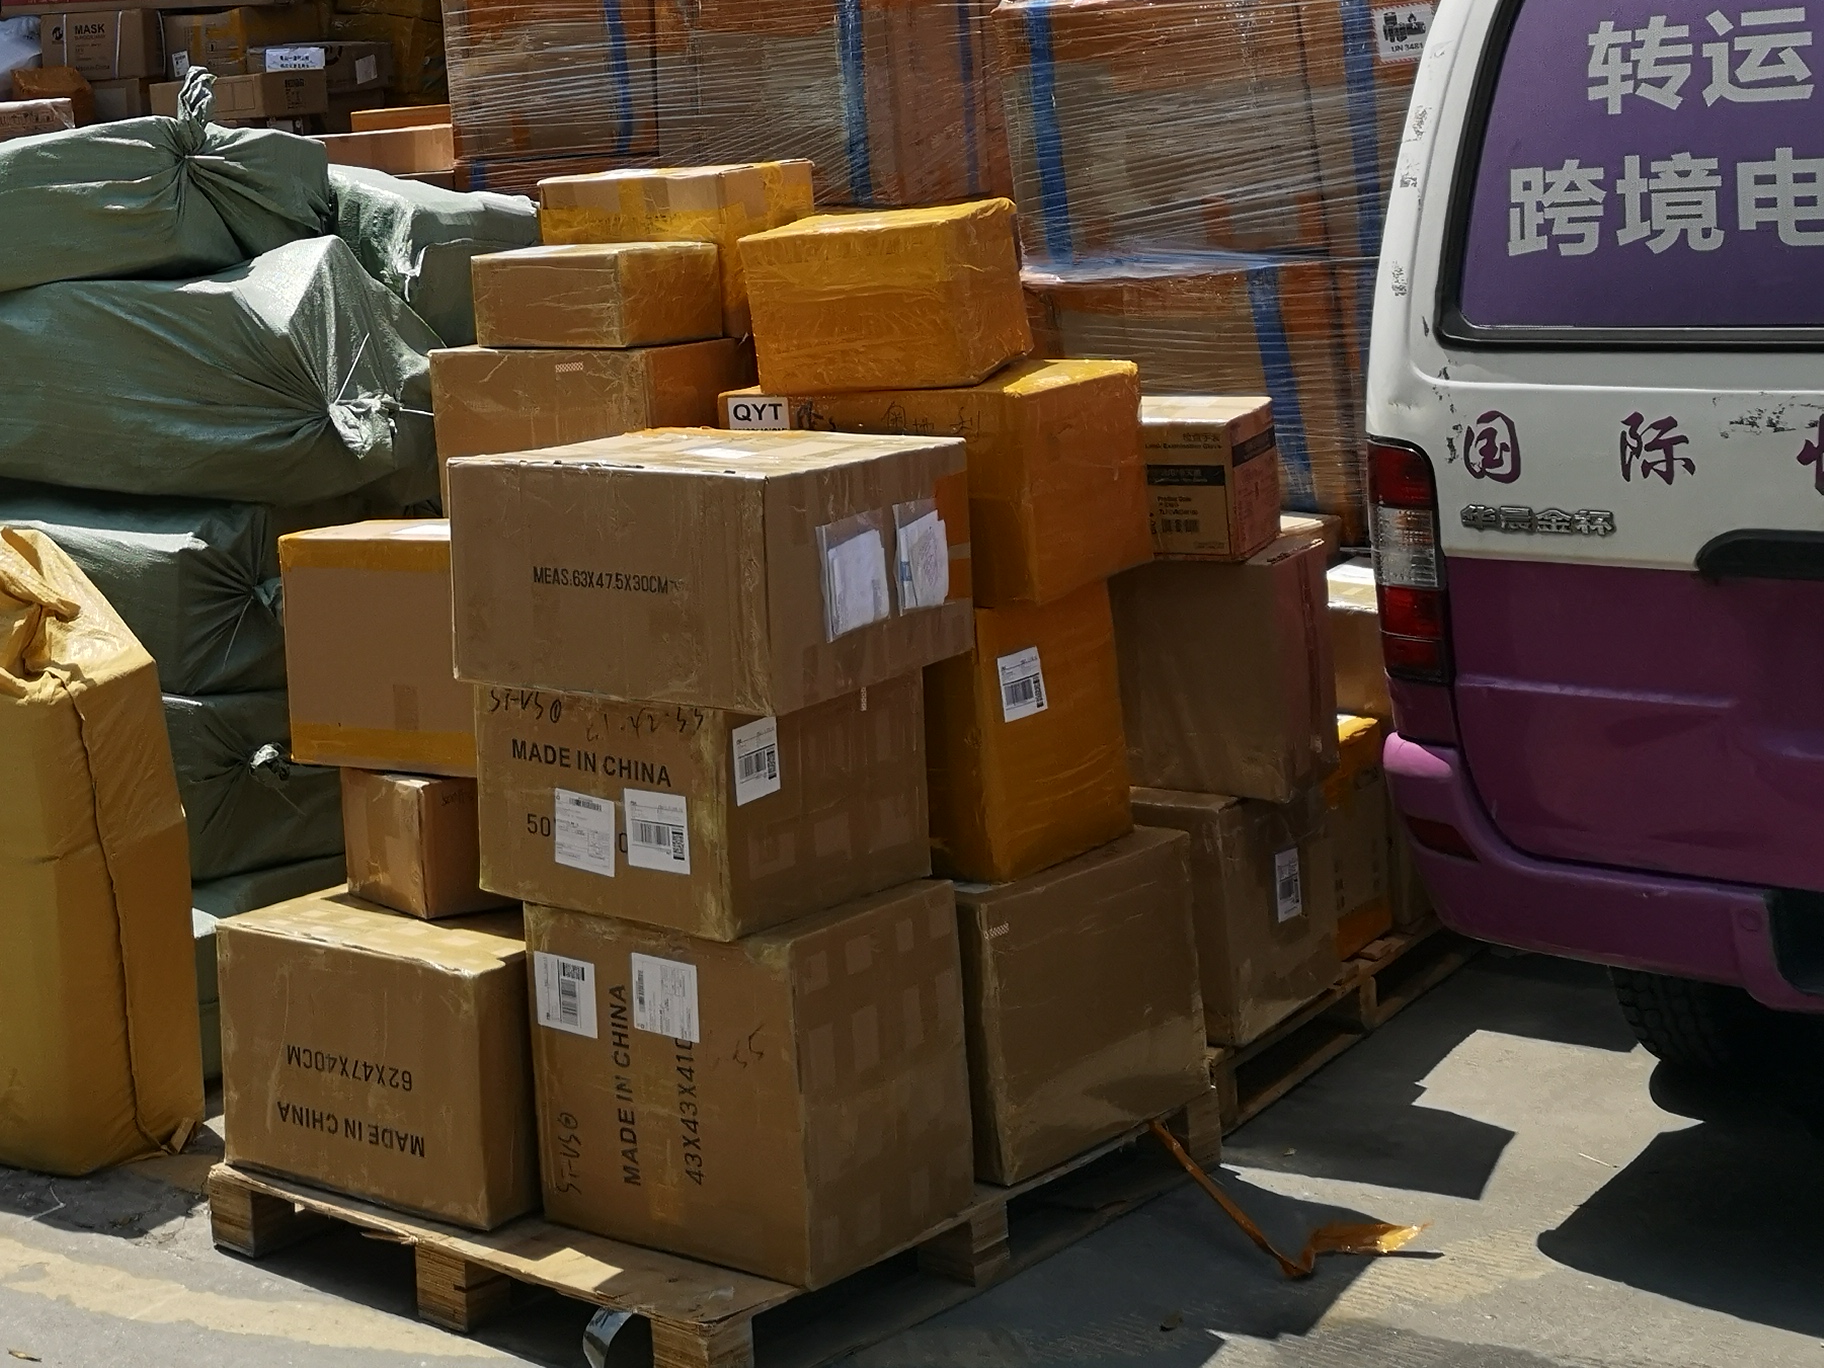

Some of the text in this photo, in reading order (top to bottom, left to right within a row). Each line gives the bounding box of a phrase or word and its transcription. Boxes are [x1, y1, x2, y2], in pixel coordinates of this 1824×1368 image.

[75, 24, 105, 34] MASK
[1587, 7, 1815, 115] 转运
[1508, 147, 1824, 256] 跨境电
[733, 402, 783, 421] QYT
[511, 738, 672, 788] MADE IN CHINA
[287, 1044, 413, 1092] 62X47X40CM
[609, 984, 641, 1186] MADE IN CHINA
[277, 1101, 426, 1158] MADE IN CHINA
